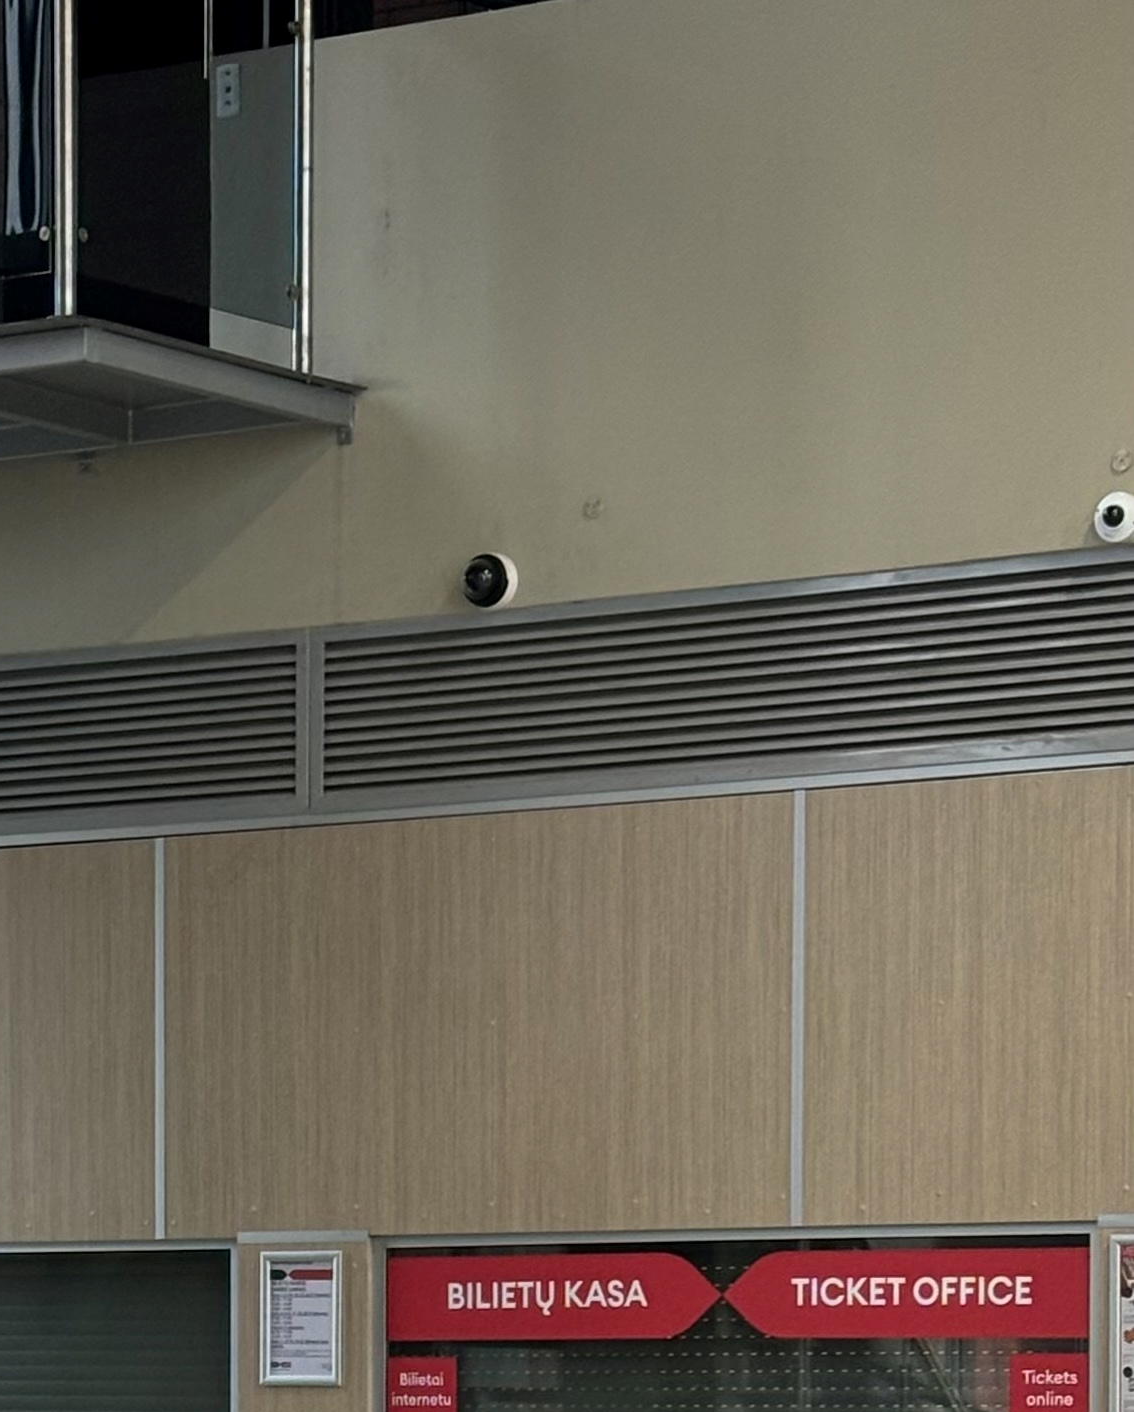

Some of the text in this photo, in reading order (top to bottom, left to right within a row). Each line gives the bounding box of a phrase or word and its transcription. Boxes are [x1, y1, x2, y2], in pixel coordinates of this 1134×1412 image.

[447, 1280, 648, 1316] BILIETŲ KASA
[791, 1276, 1033, 1307] TICKET OFFICE
[399, 1371, 445, 1387] Bilietai
[1021, 1369, 1079, 1385] Tickets
[1026, 1390, 1074, 1407] online
